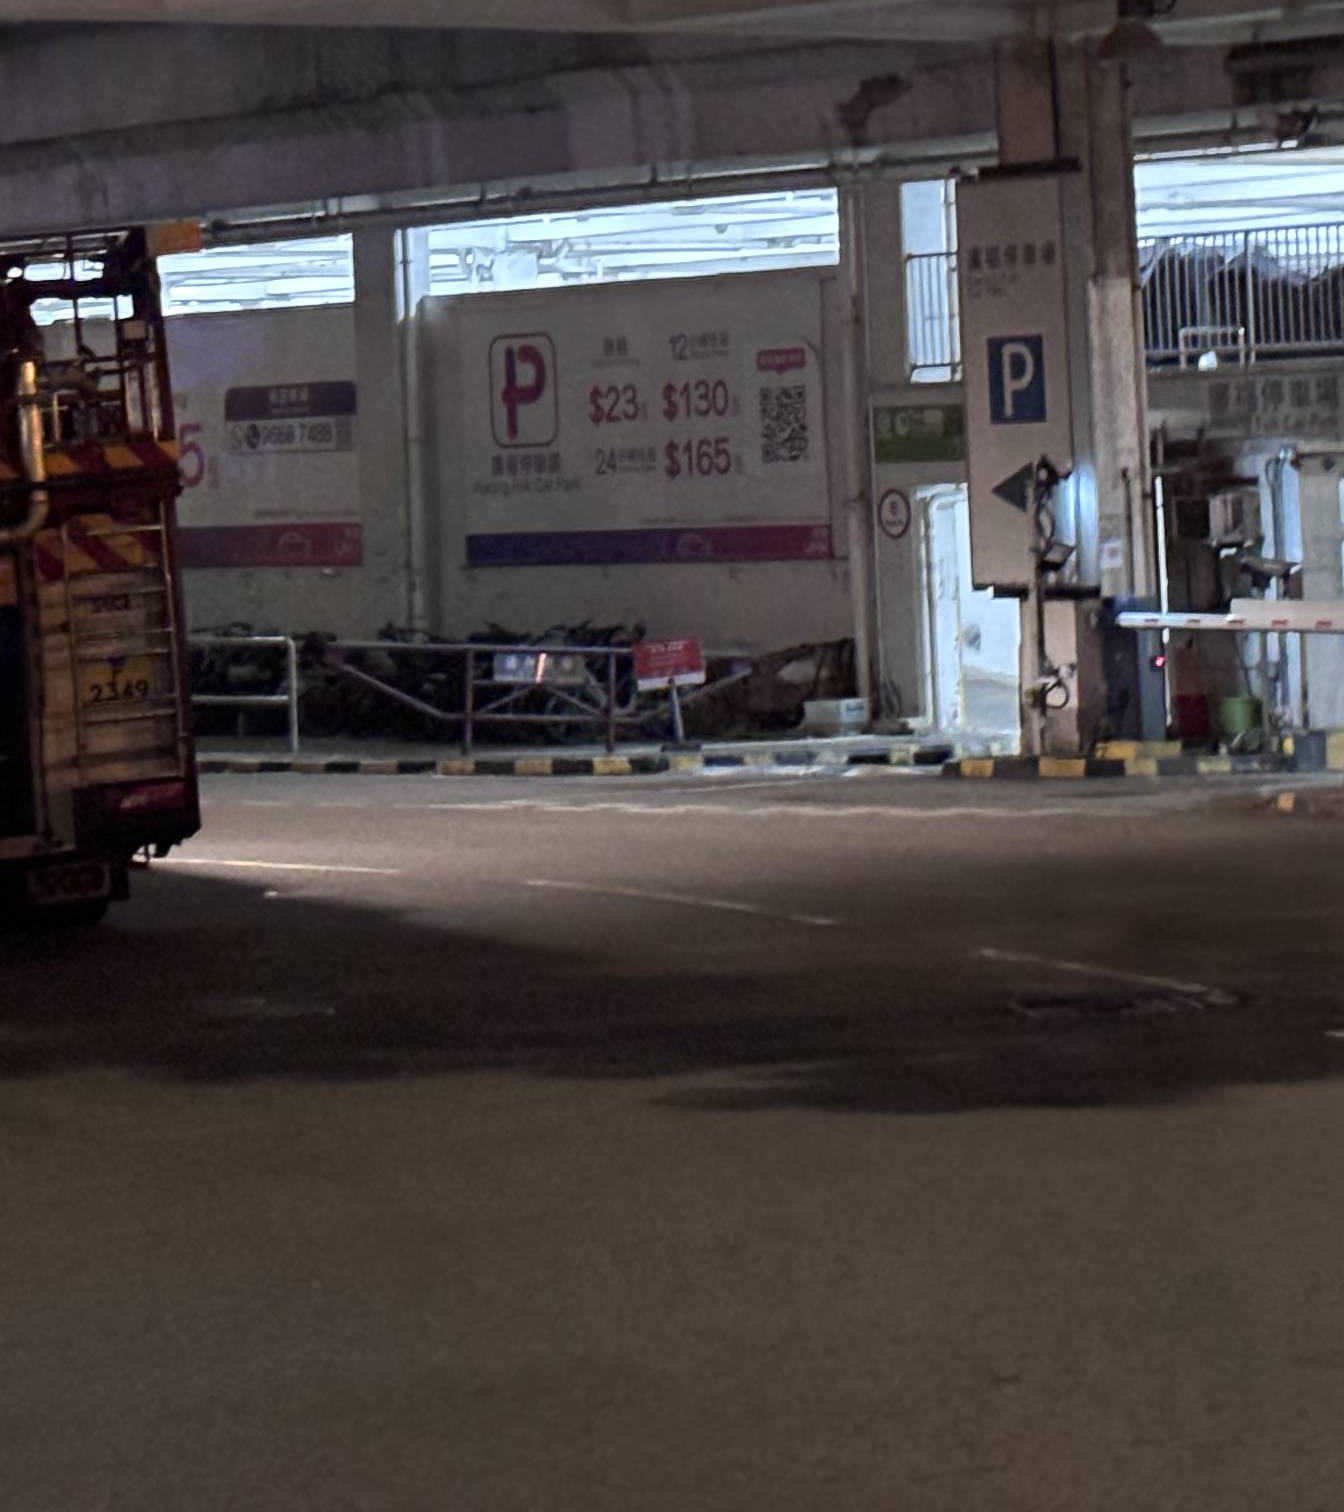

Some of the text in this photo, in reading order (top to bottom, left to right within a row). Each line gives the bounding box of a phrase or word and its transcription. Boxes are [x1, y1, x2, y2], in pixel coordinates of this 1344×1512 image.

[662, 380, 729, 421] $130
[1001, 343, 1034, 418] P
[590, 384, 640, 426] $23
[664, 438, 732, 480] $165
